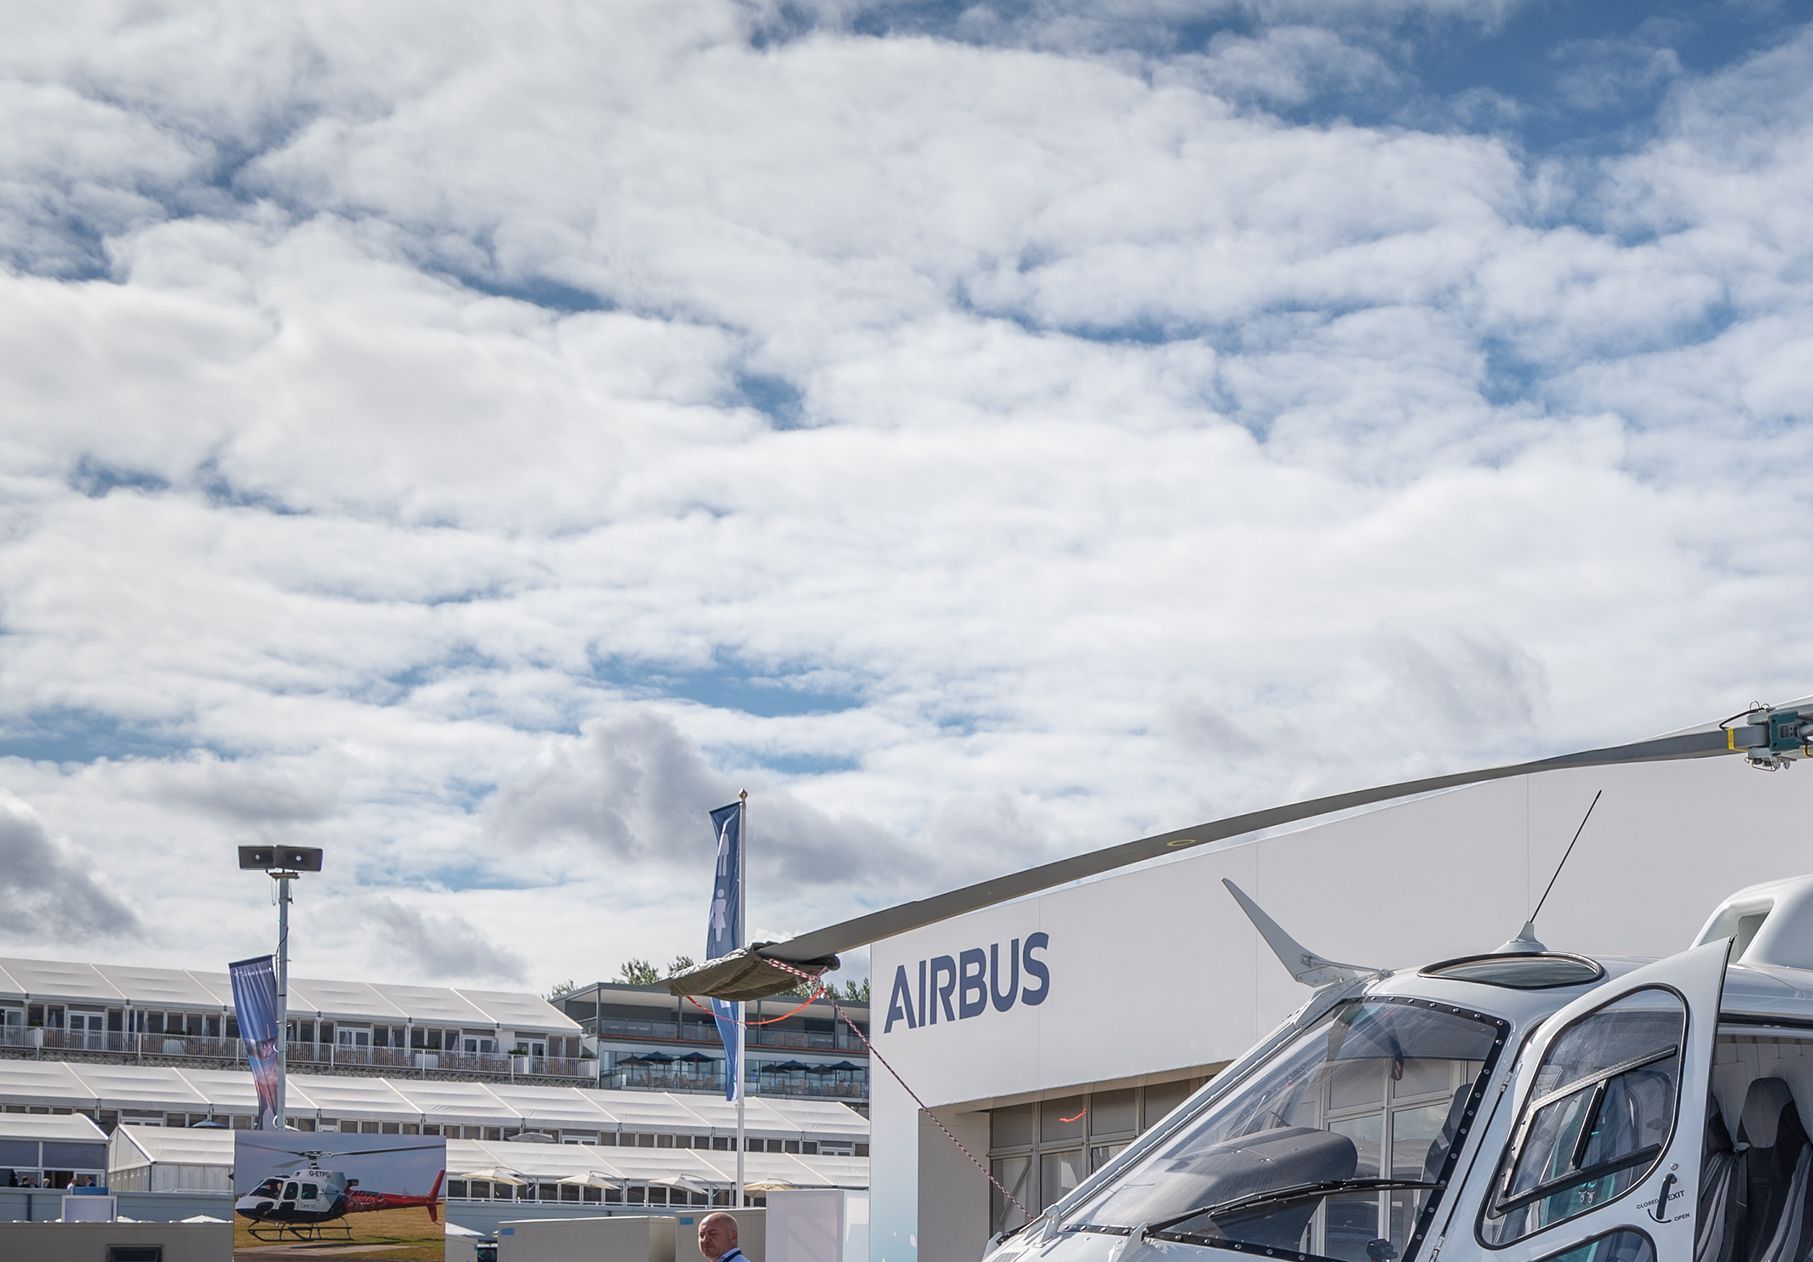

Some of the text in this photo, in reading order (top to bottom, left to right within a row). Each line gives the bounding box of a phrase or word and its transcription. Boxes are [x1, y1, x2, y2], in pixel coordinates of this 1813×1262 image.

[883, 931, 1050, 1034] AIRBUS
[1667, 1190, 1685, 1201] EXIT
[1636, 1198, 1659, 1210] CLOSED
[1674, 1213, 1690, 1222] OPEN
